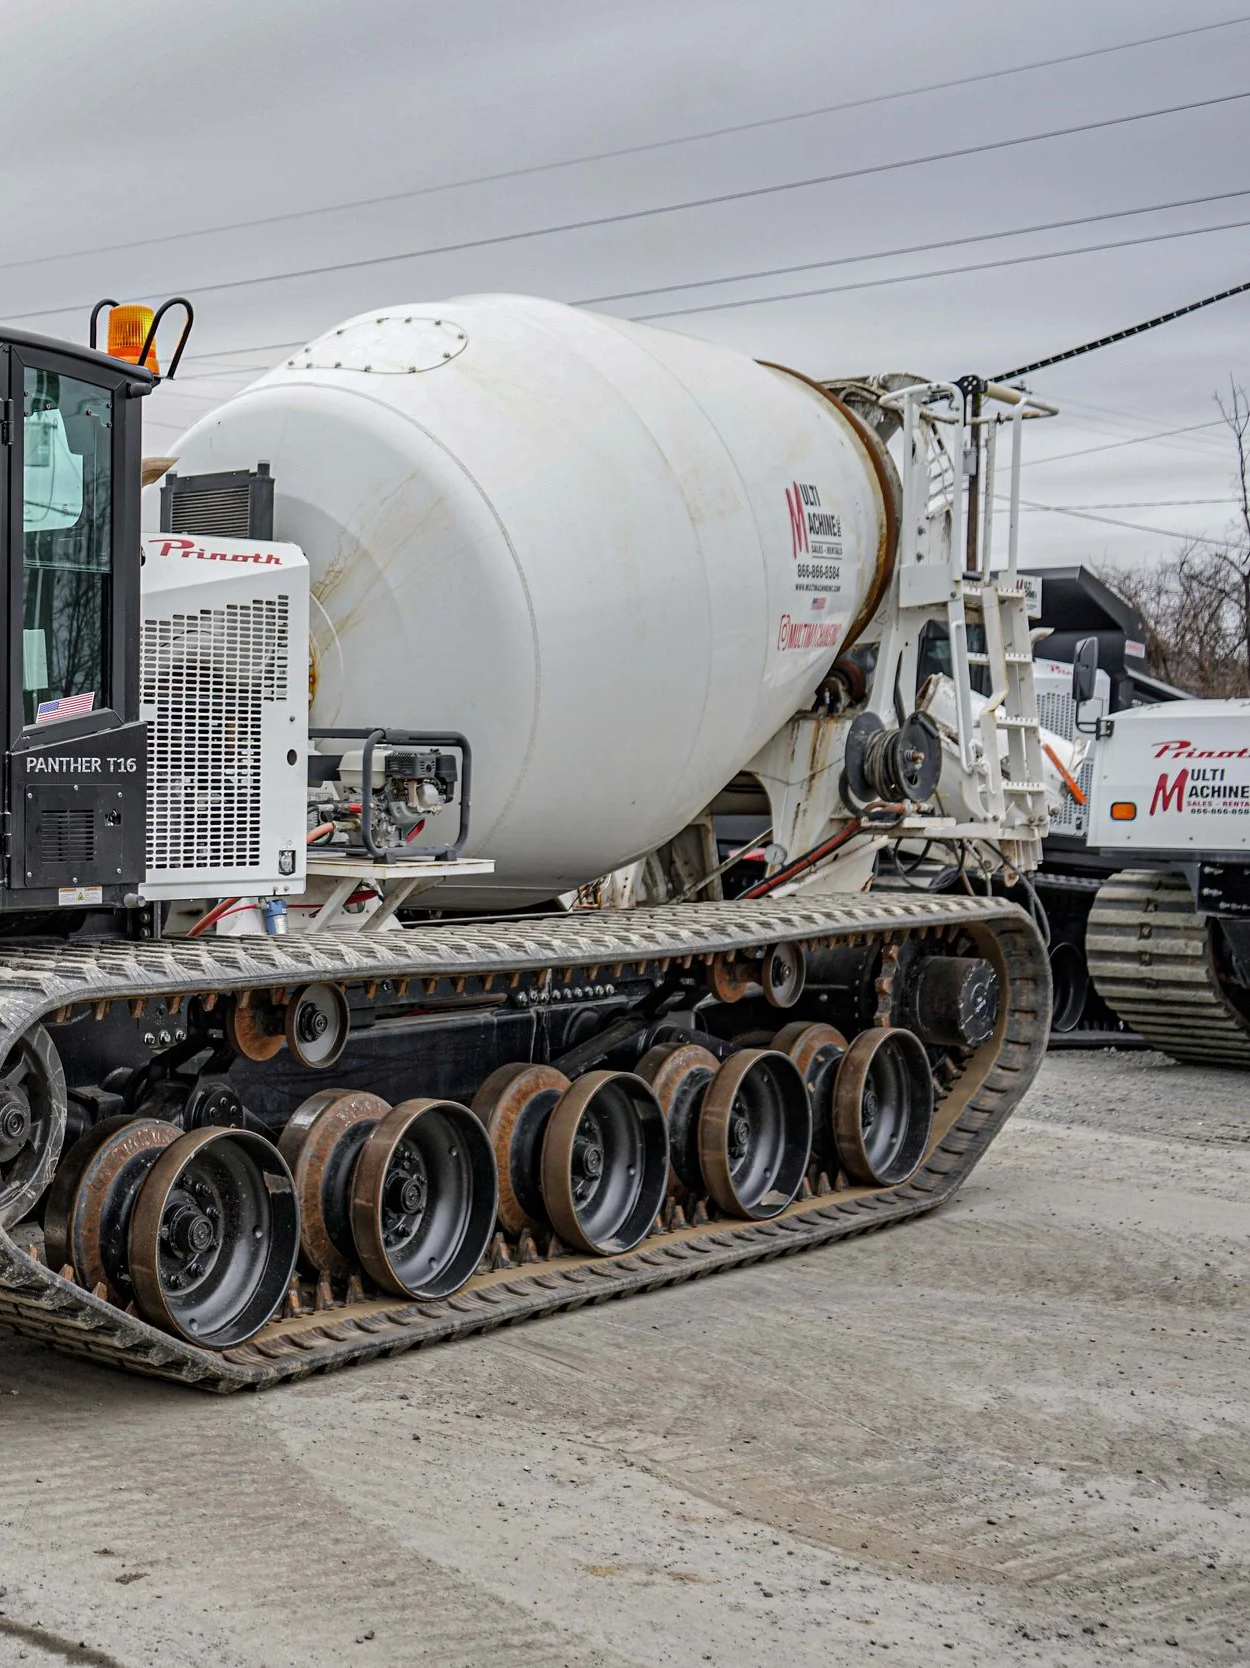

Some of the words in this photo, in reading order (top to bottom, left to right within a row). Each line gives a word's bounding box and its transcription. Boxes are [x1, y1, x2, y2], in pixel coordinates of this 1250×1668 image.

[148, 539, 282, 565] Prinoth
[797, 563, 840, 579] 866-866-8584
[1151, 740, 1250, 758] Prinot
[26, 757, 102, 773] PANTHER
[106, 757, 137, 773] T16
